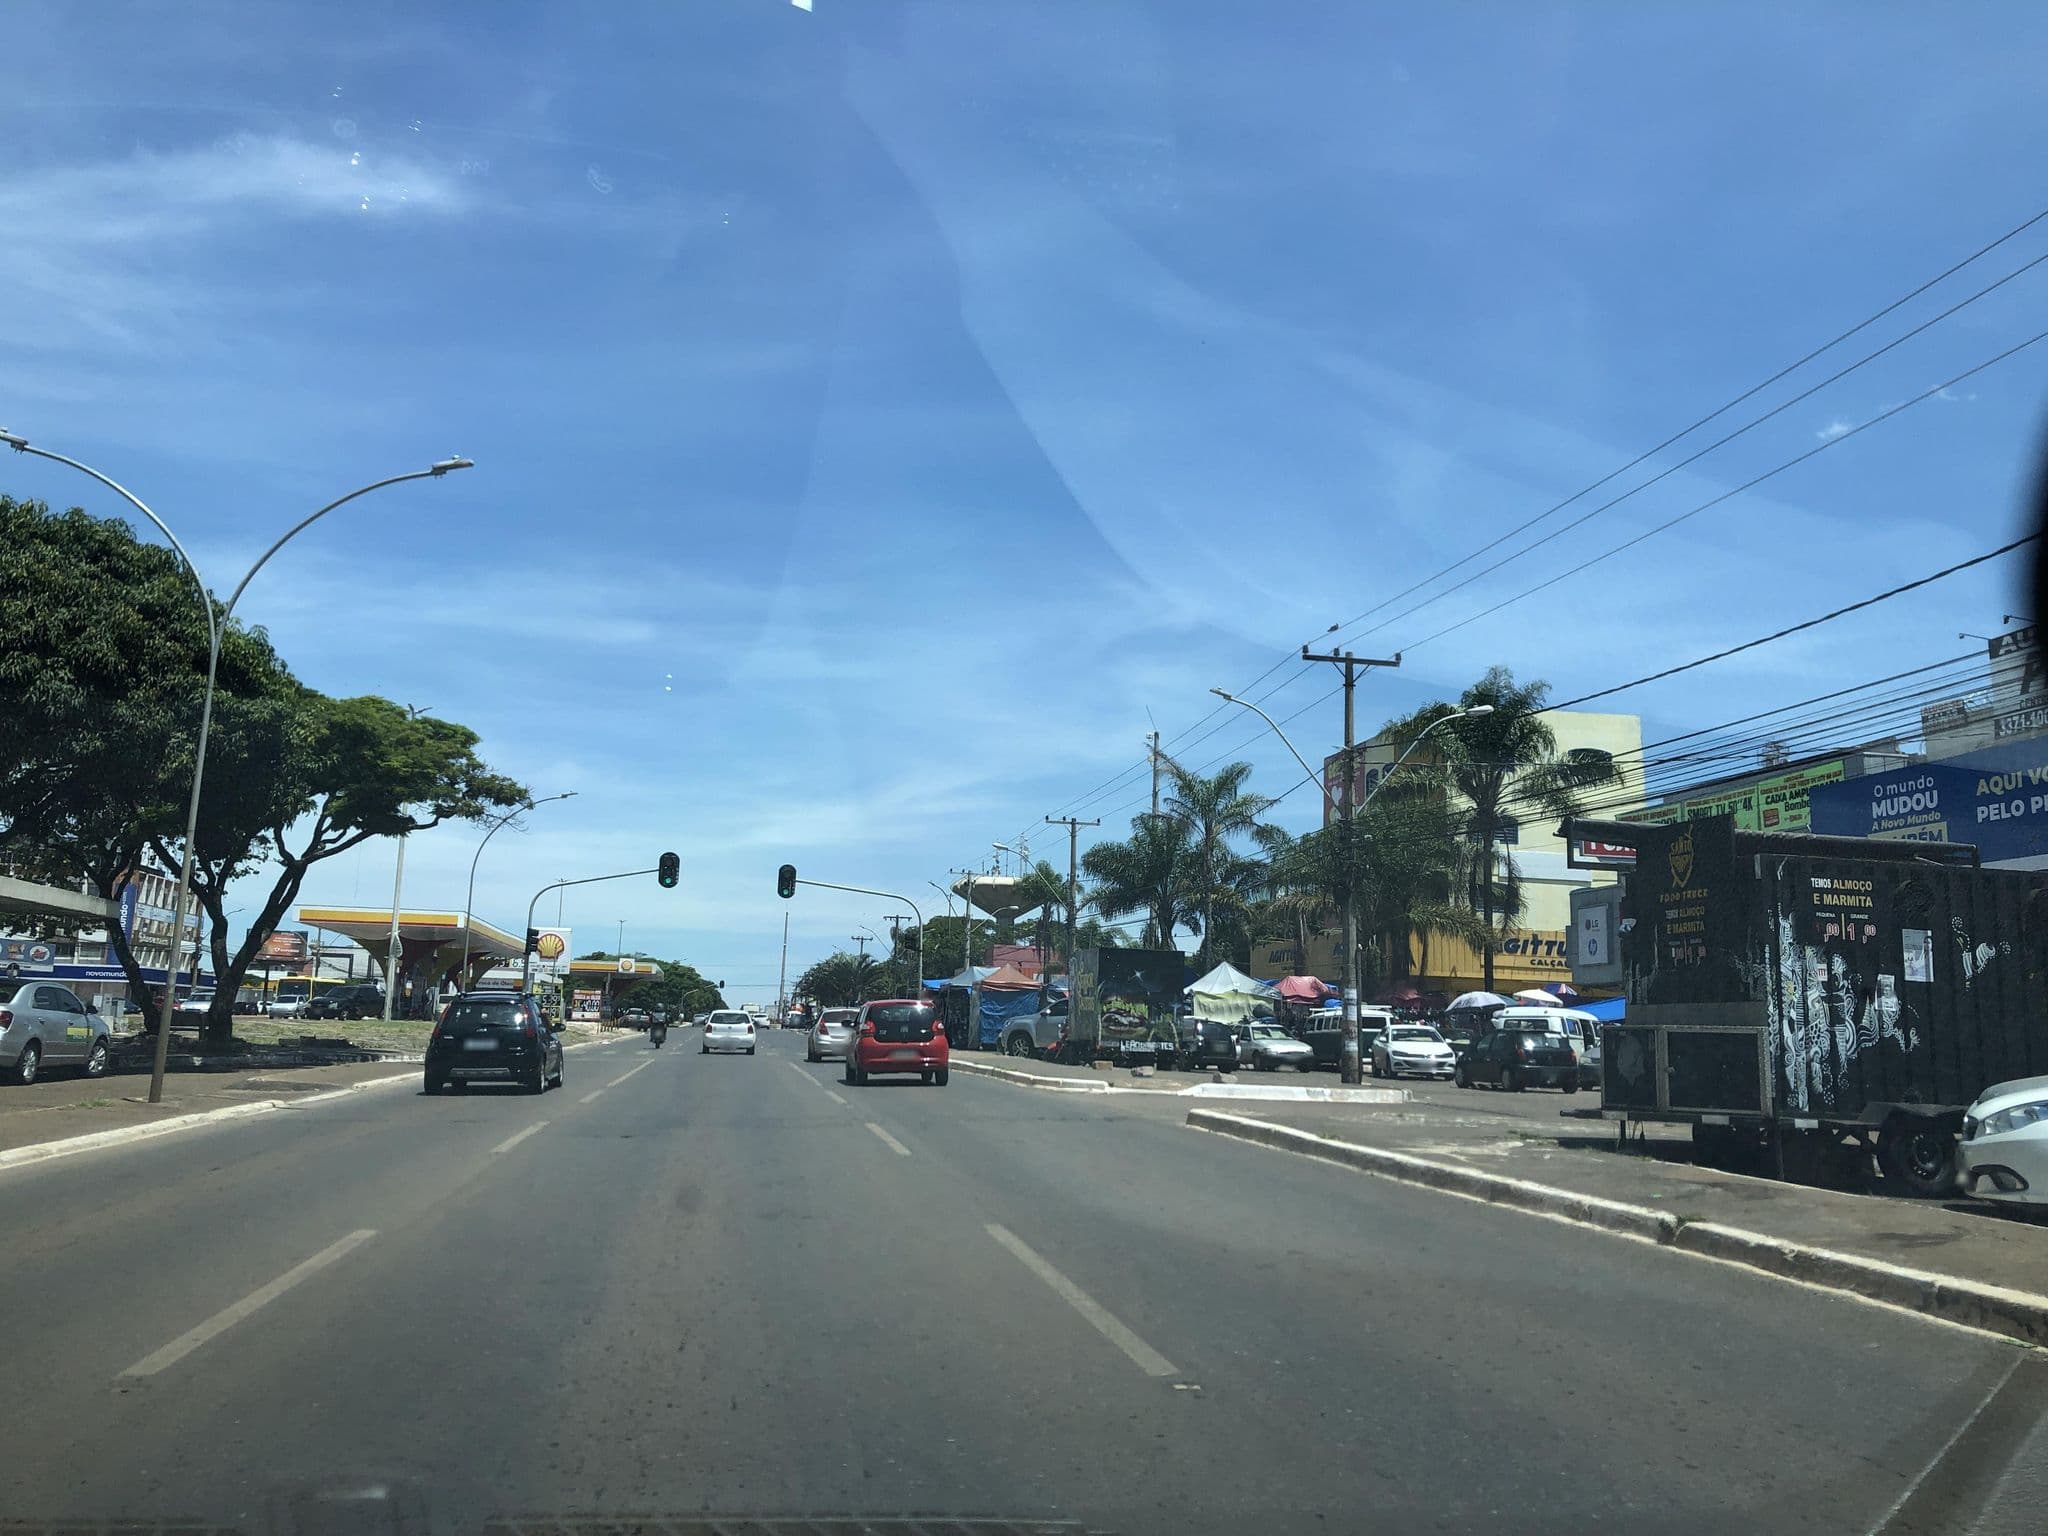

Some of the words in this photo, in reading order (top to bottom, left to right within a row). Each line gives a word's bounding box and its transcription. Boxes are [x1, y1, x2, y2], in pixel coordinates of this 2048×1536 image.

[1874, 785, 1884, 797] O
[1886, 775, 1934, 795] mundo
[1976, 771, 2023, 796] AQUI
[1872, 789, 1938, 819] MUDOU
[1977, 800, 2025, 824] PELO
[1871, 821, 1880, 831] A
[1881, 817, 1905, 831] Novo
[1907, 810, 1941, 824] Mundo
[1810, 878, 1832, 889] TEMOS
[1833, 879, 1873, 893] ALMOÇO
[1813, 894, 1821, 905] E
[1823, 894, 1873, 908] MARMITA
